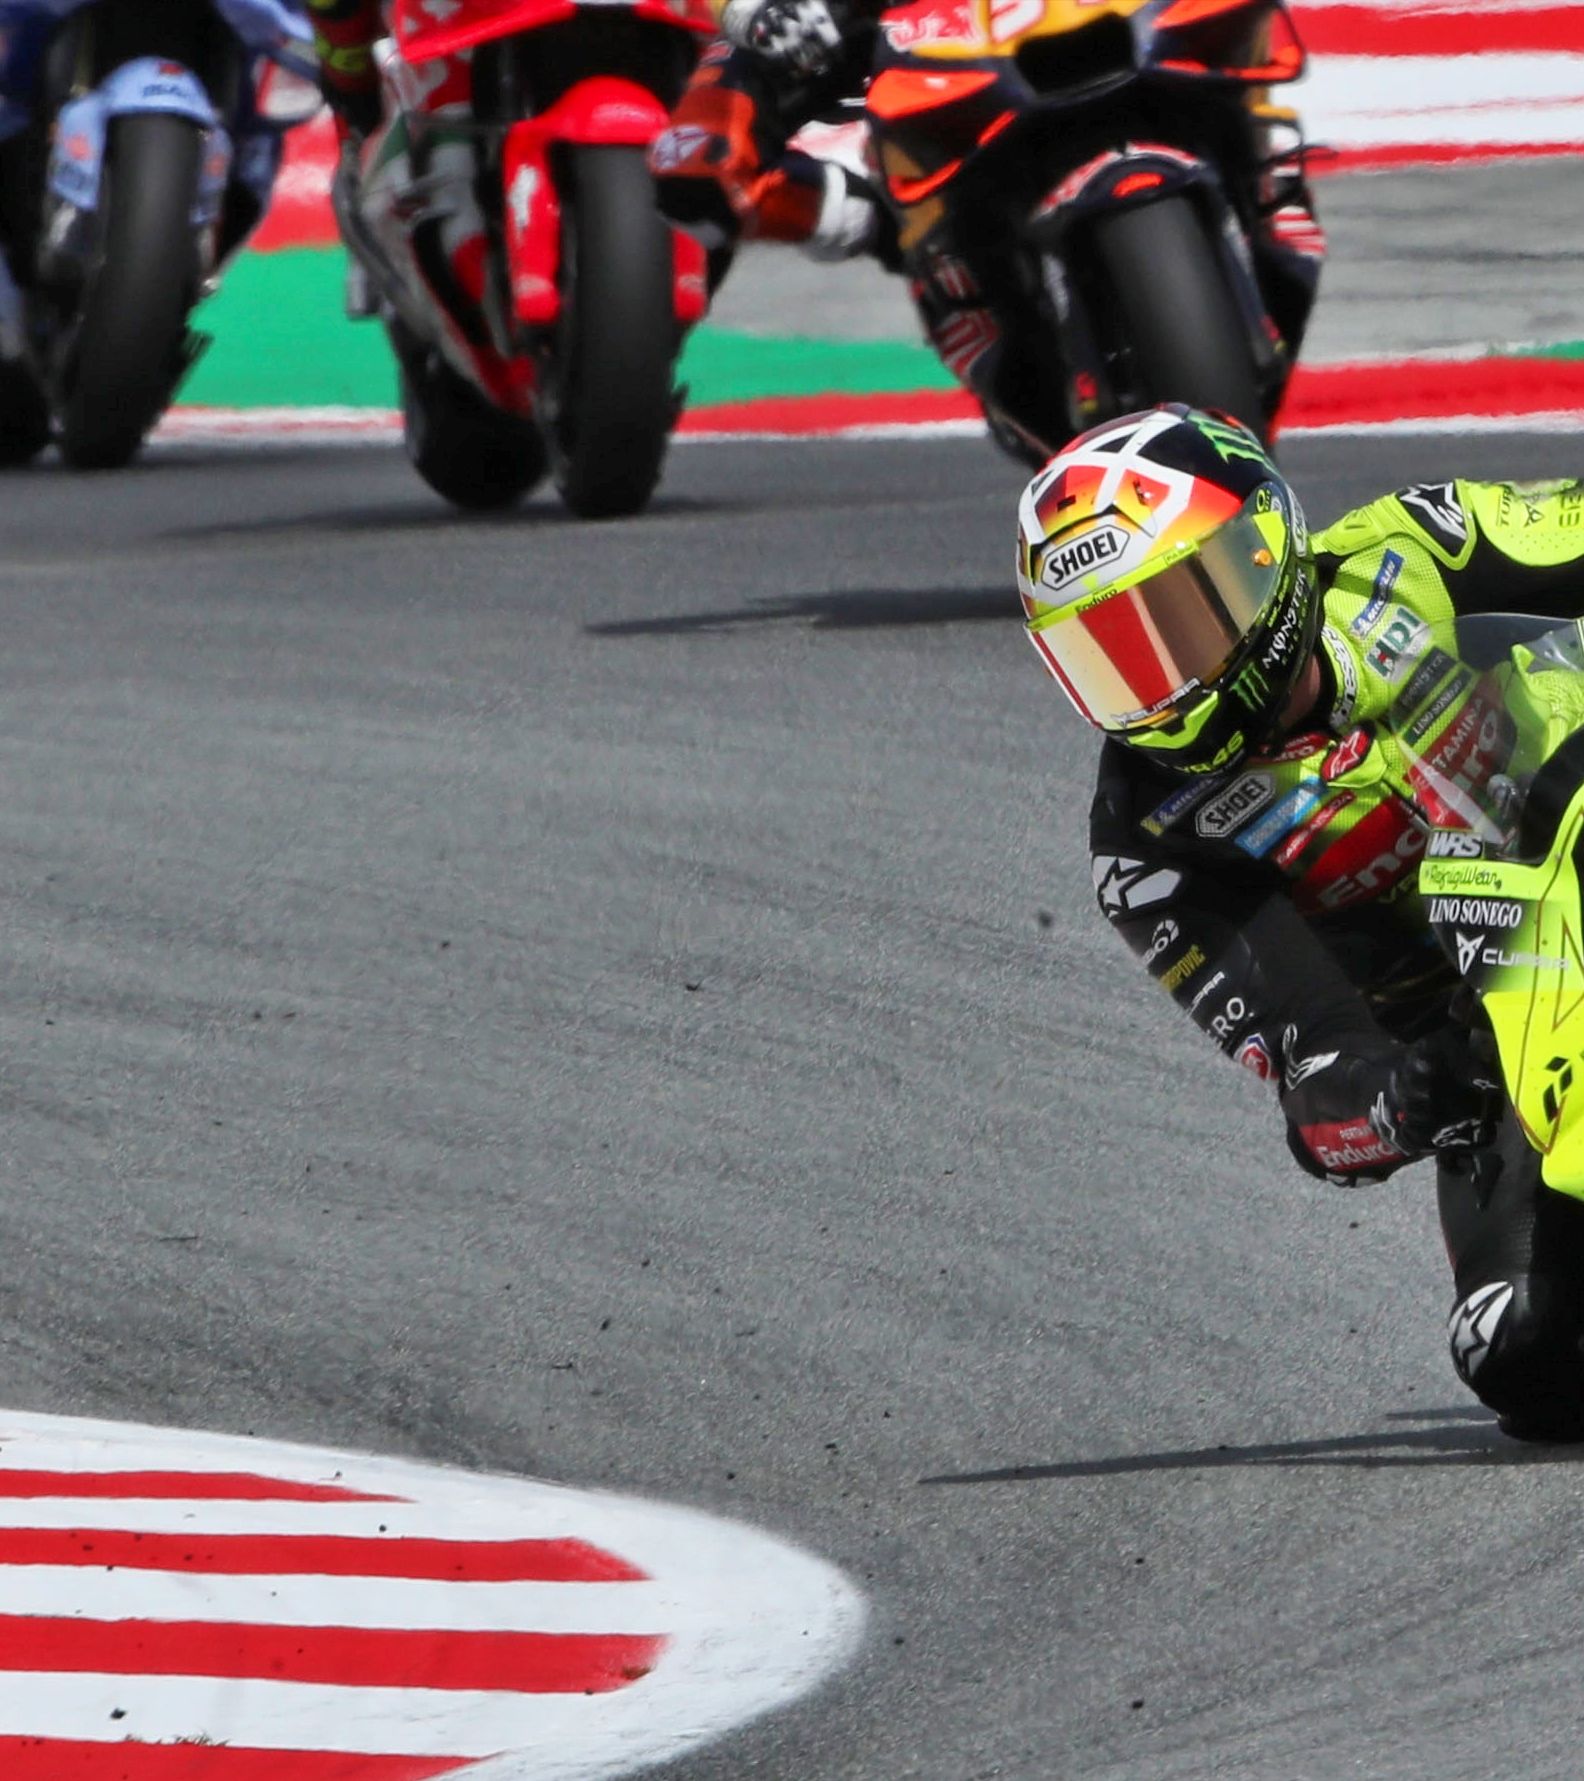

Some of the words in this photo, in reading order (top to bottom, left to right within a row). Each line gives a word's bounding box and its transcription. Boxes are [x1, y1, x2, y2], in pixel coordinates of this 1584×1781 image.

[1048, 531, 1118, 584] SHOEI
[1204, 776, 1270, 832] SHOEI
[1429, 831, 1482, 858] WRS
[1429, 898, 1461, 924] LINO
[1459, 898, 1523, 928] SONEGO
[1482, 947, 1569, 970] CUPRA
